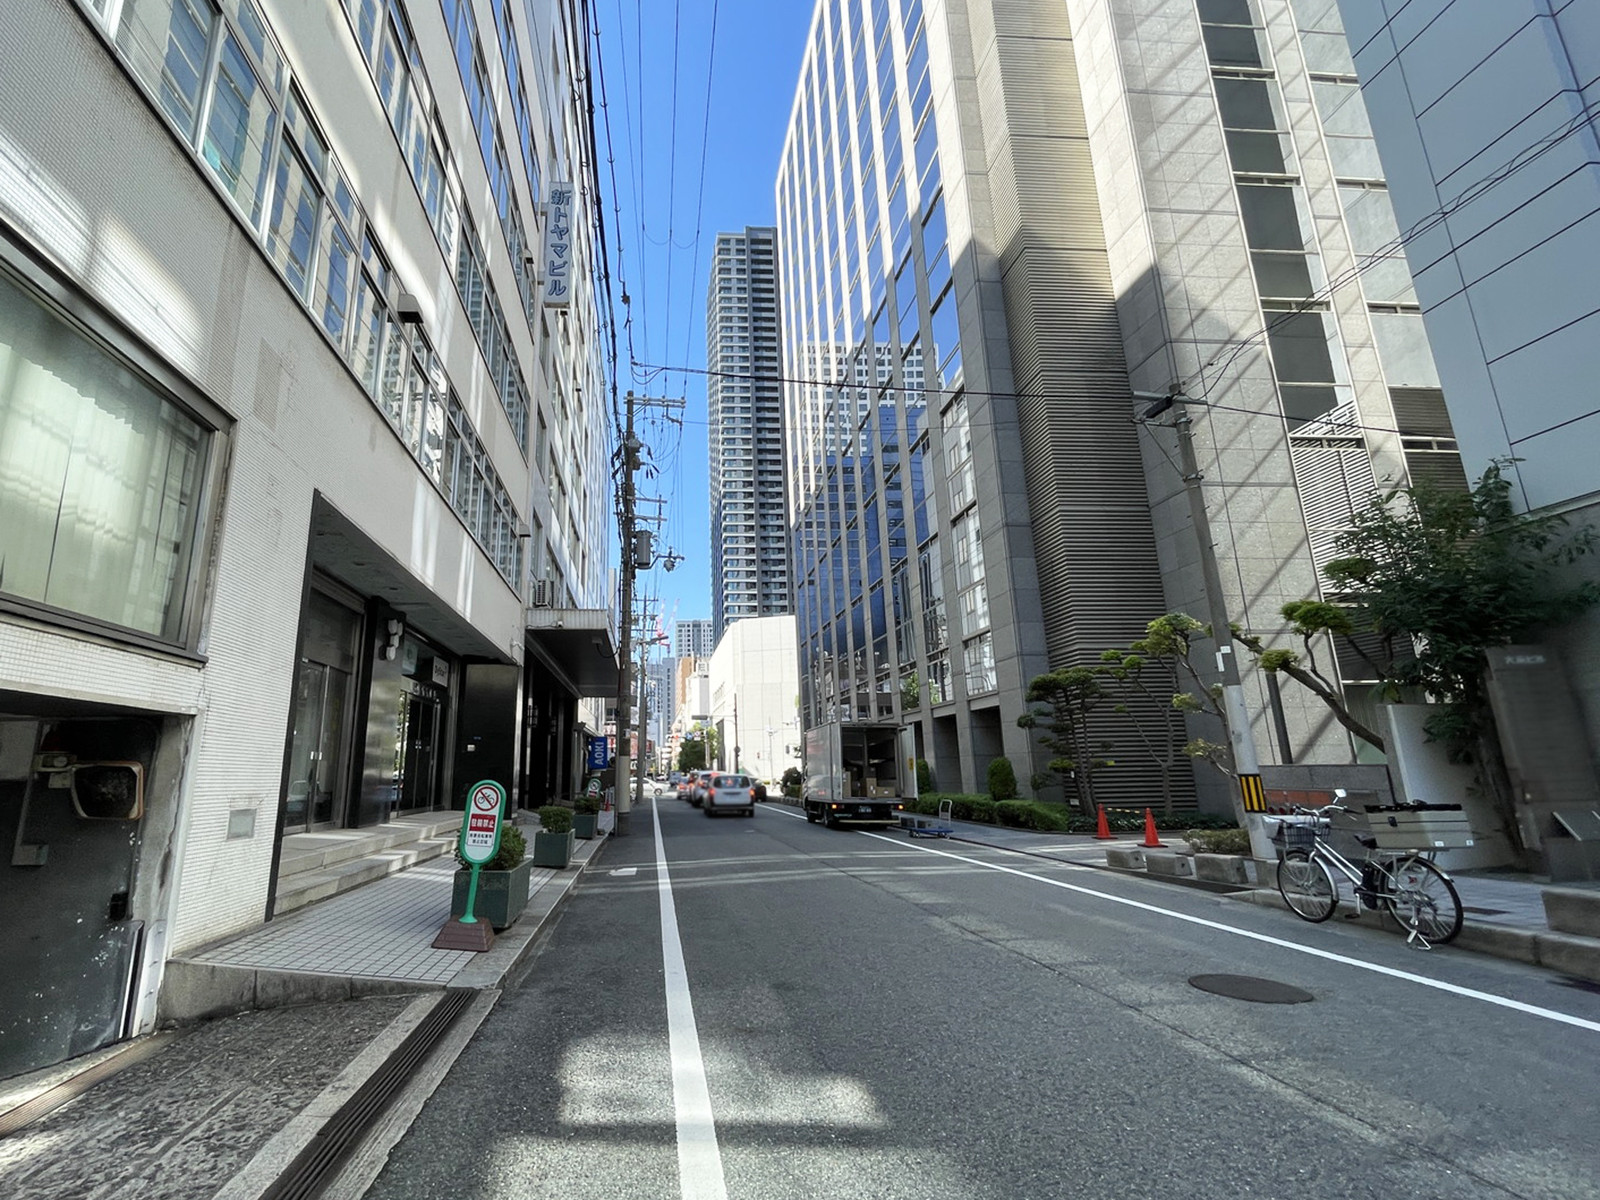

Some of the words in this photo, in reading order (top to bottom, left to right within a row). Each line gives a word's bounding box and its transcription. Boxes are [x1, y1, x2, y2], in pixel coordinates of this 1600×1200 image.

[548, 189, 571, 296] 新トヤマビル
[594, 741, 605, 766] AOKI
